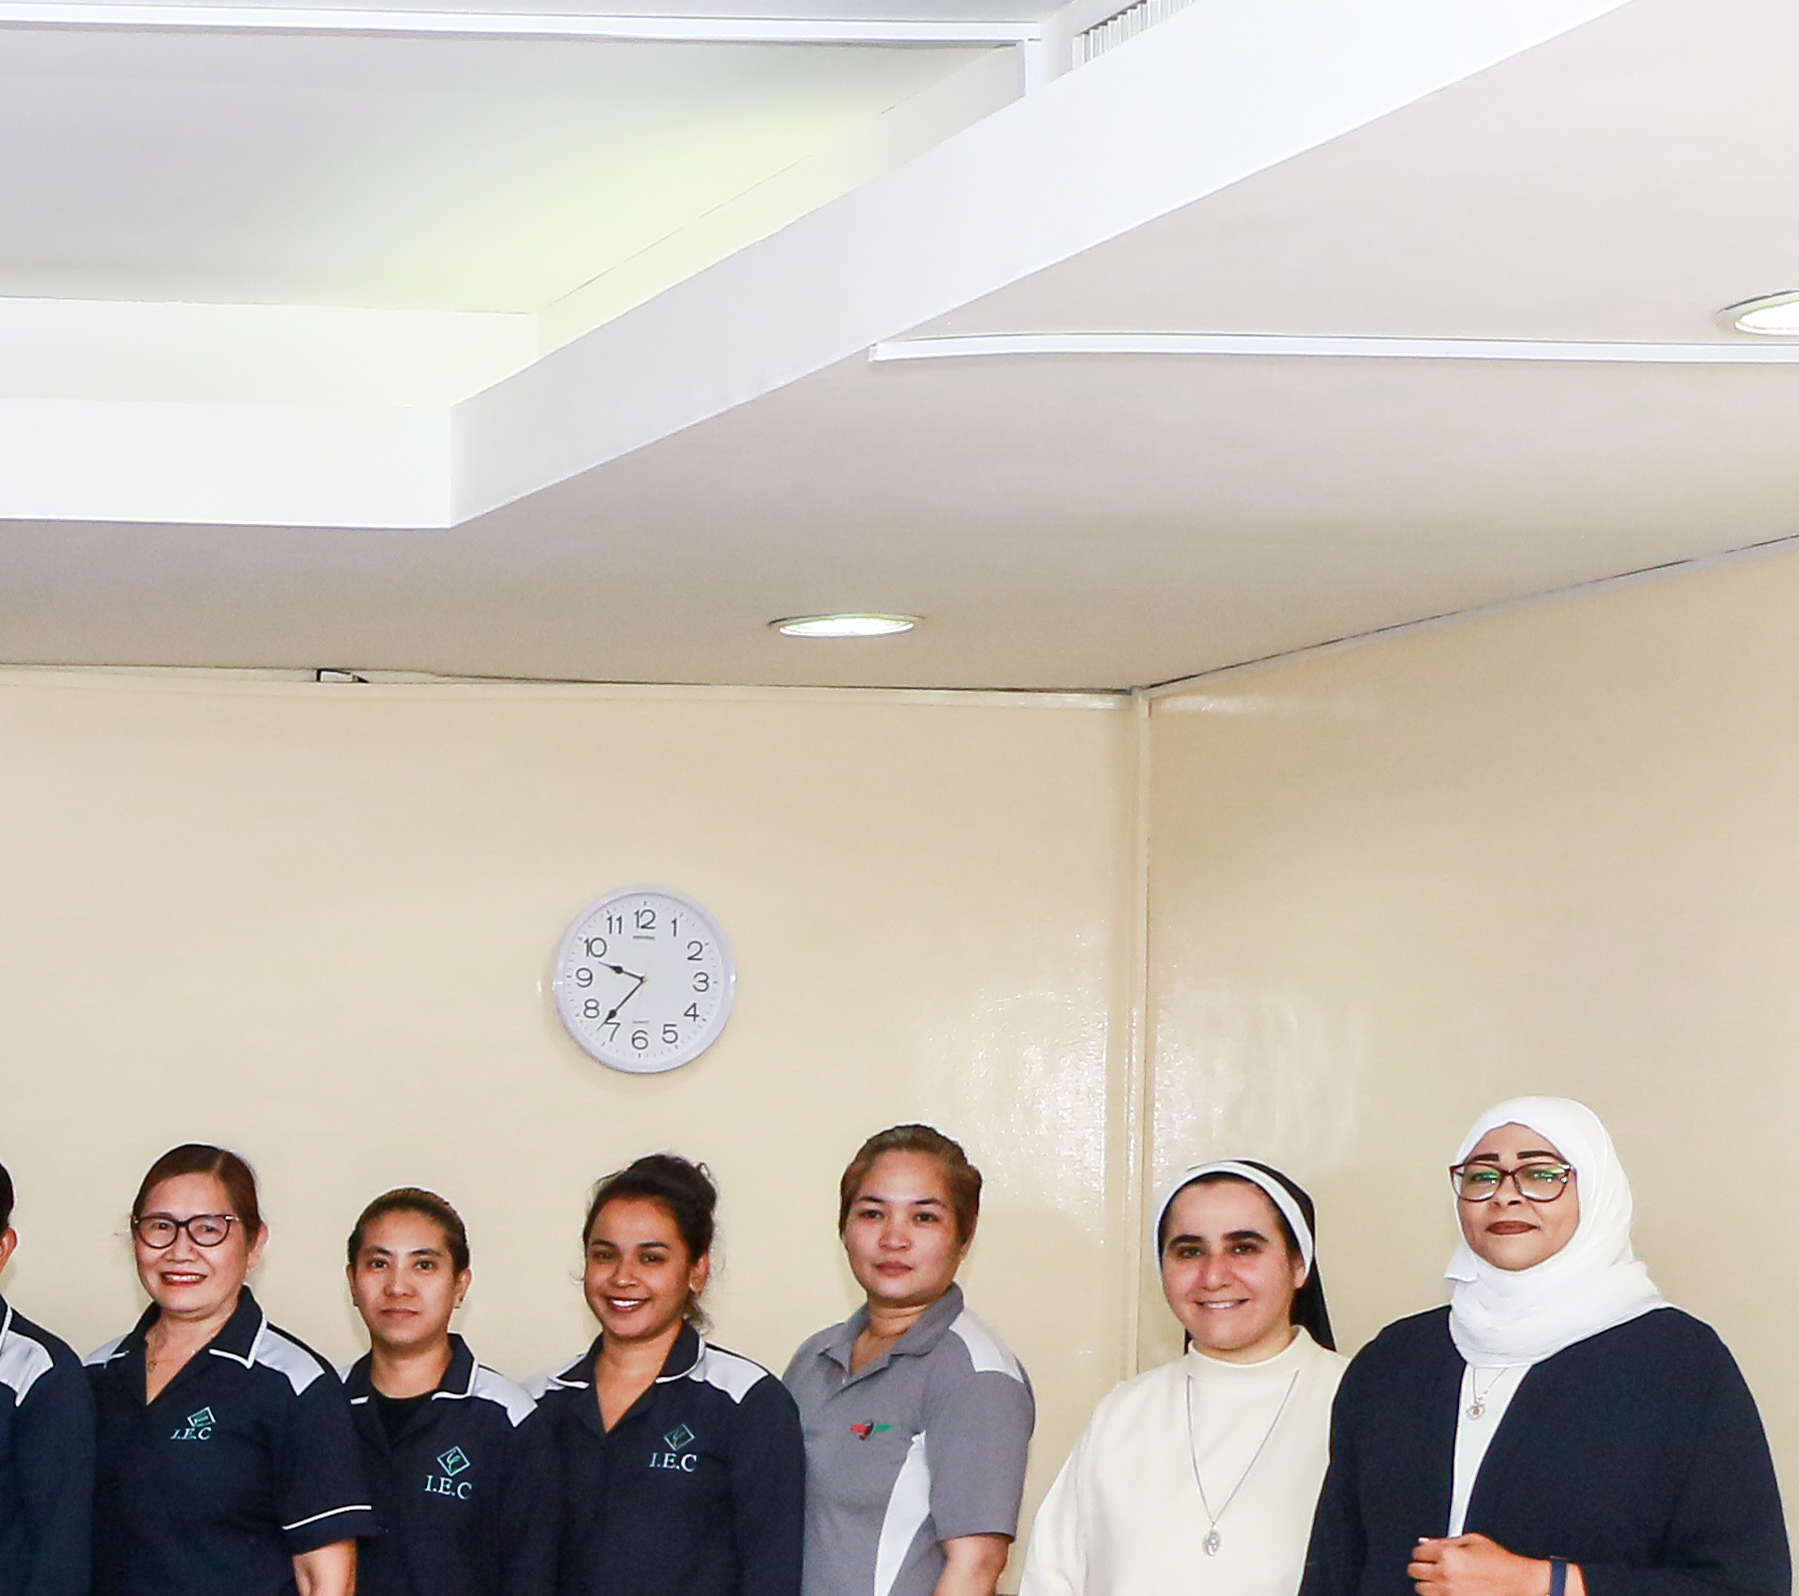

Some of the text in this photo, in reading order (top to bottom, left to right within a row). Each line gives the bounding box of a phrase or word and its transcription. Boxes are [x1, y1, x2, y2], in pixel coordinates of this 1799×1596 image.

[607, 915, 622, 935] 11
[634, 909, 656, 929] 12
[671, 918, 677, 937] 1
[584, 937, 607, 958] 10
[687, 940, 703, 961] 2
[576, 967, 593, 988] 9
[693, 972, 710, 992] 3
[583, 998, 600, 1019] 8
[683, 1002, 700, 1022] 4
[605, 1021, 621, 1042] 7
[631, 1030, 649, 1050] 6
[661, 1024, 679, 1044] 5
